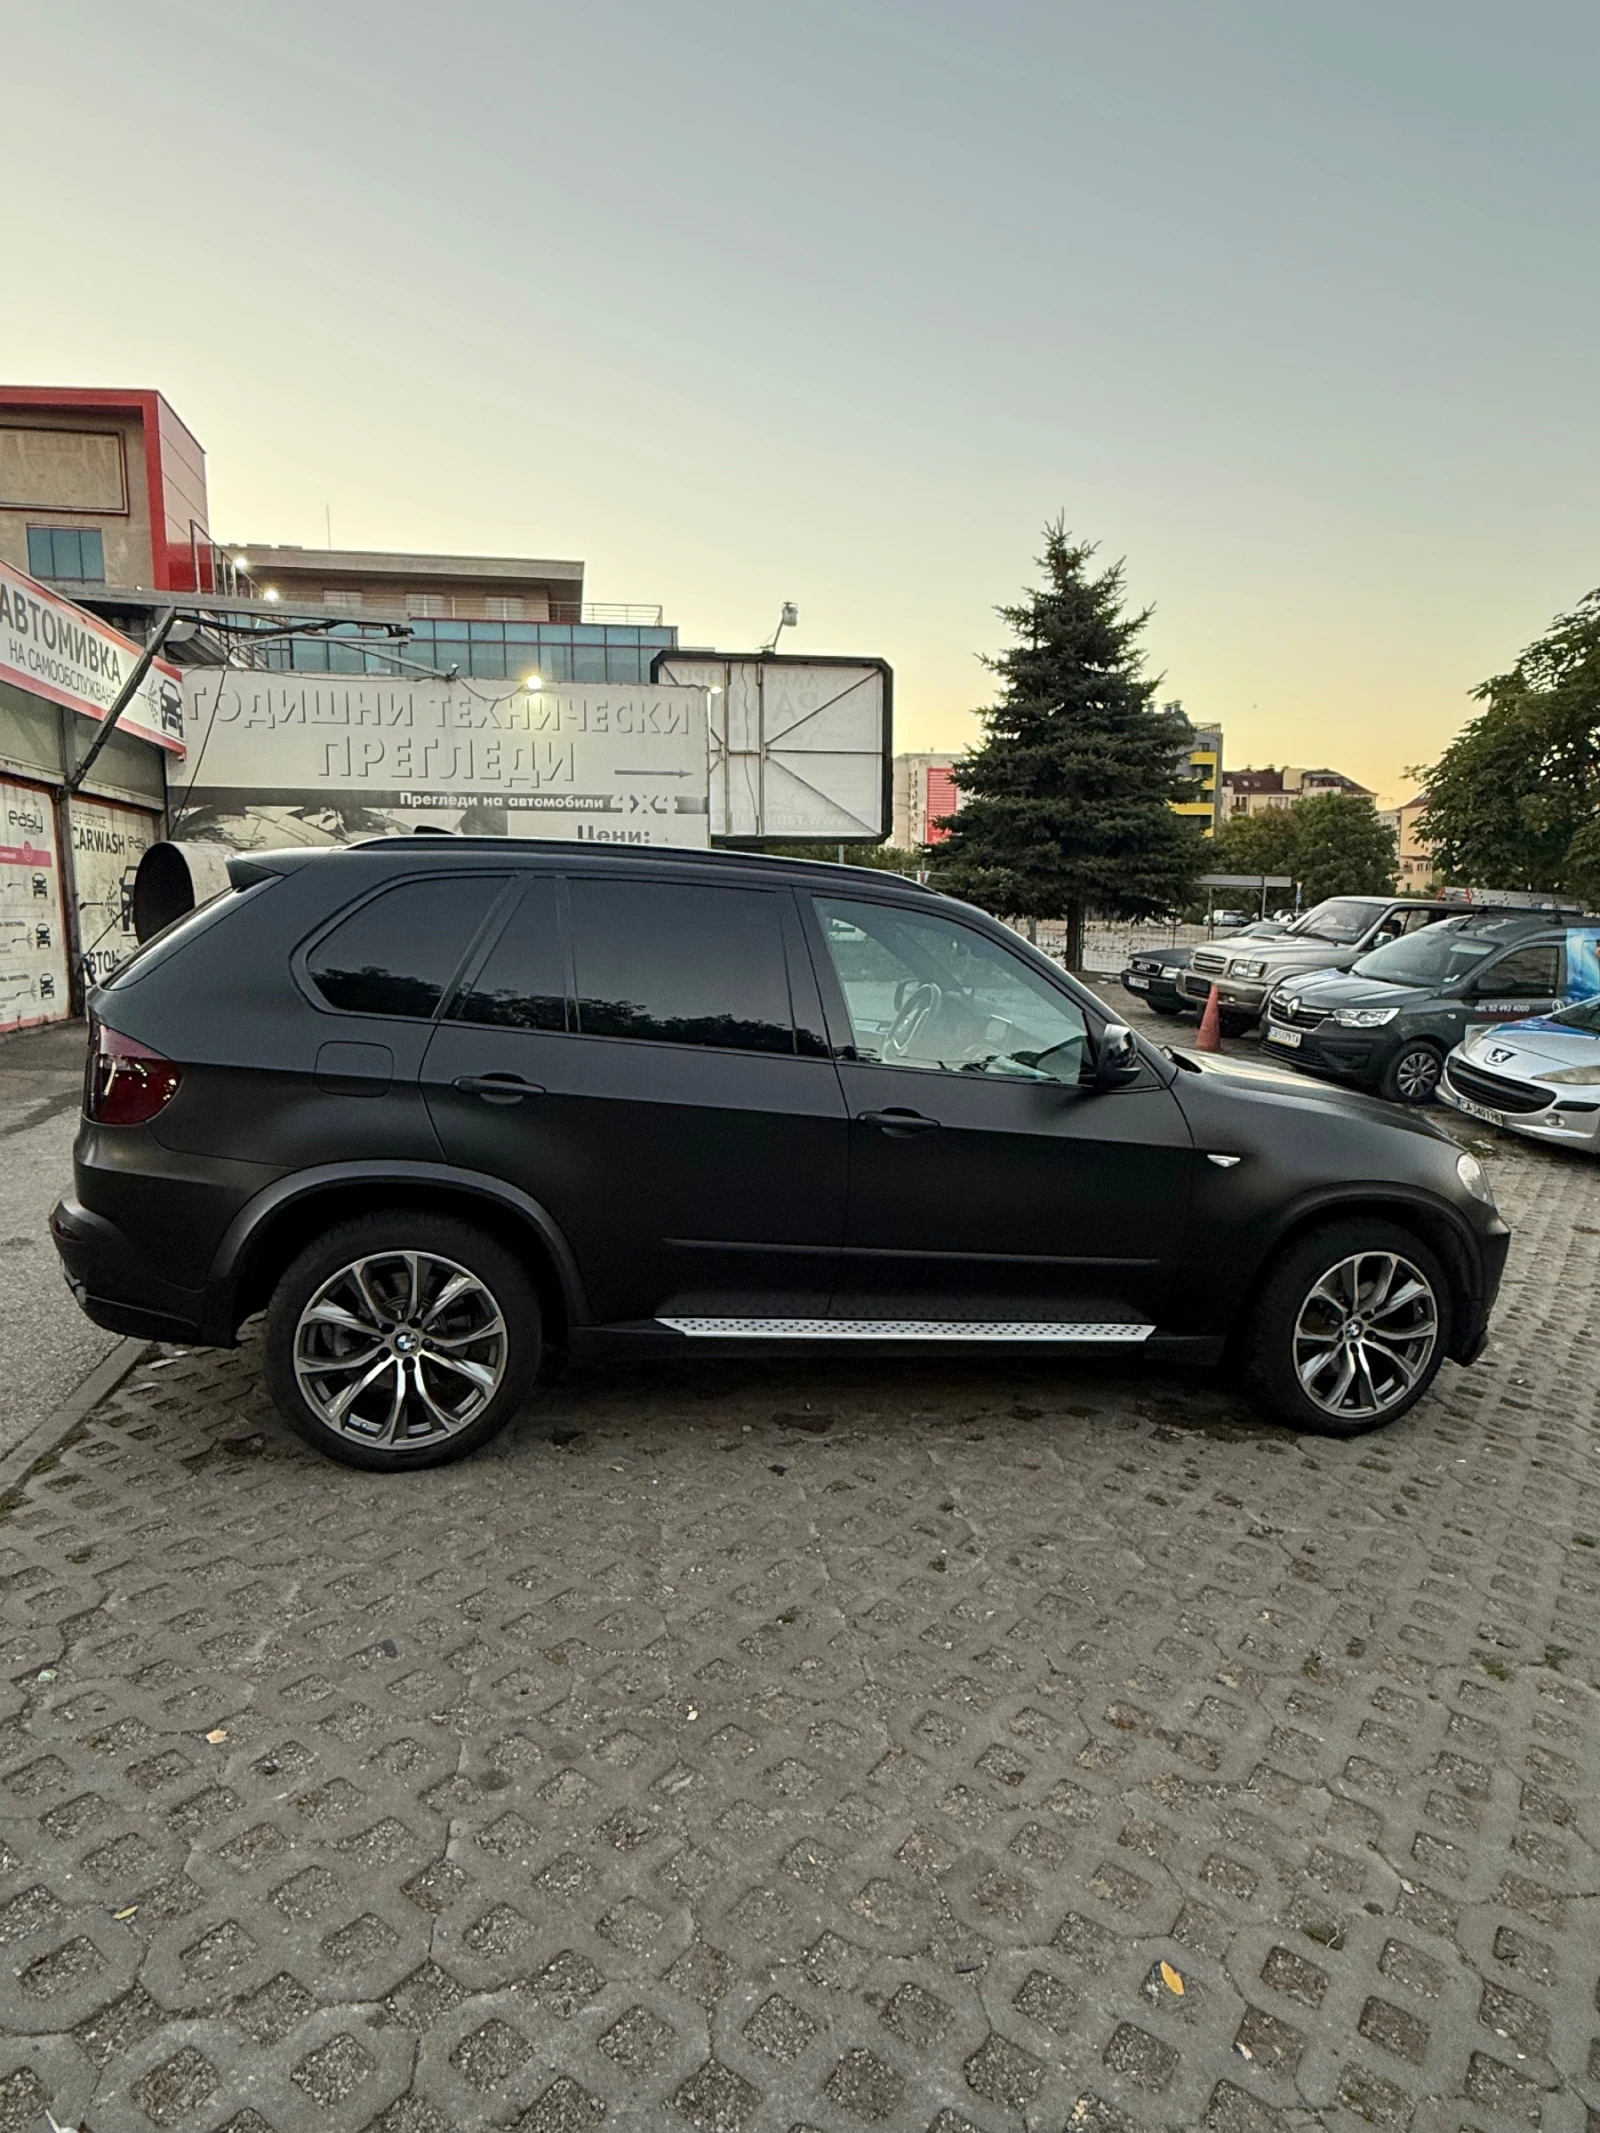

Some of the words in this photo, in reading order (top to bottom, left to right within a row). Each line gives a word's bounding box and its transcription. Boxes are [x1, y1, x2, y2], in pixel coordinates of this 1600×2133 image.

[0, 583, 122, 686] АВТОМИВКА
[9, 638, 26, 666] НА
[188, 686, 413, 728] ГОДИШНИ
[428, 696, 689, 735] ТЕХНИЧЕСКИ
[318, 737, 574, 788] ПРЕГЛЕДИ
[400, 792, 478, 808] Прегледи
[483, 797, 503, 807] на
[508, 795, 604, 809] автомобили
[8, 809, 43, 834] easy
[577, 825, 651, 843] Цени:
[73, 826, 126, 855] CARWASH
